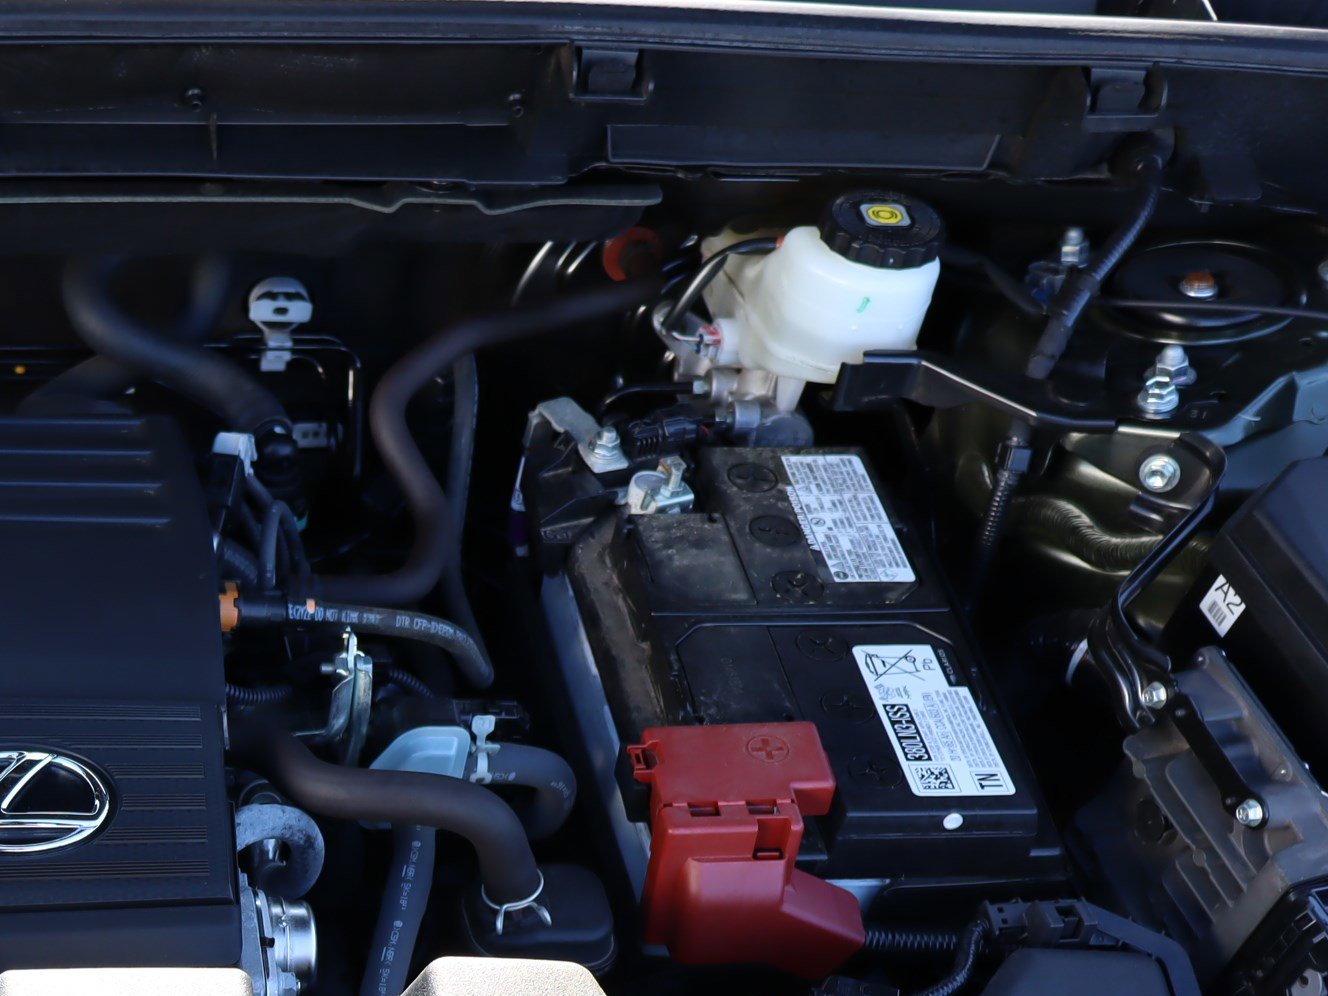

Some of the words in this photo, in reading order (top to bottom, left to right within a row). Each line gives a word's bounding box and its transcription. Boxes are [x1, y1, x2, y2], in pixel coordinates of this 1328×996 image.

[1215, 581, 1243, 616] A2
[922, 658, 936, 671] Pb
[885, 705, 929, 760] 380LN3-ISS
[974, 773, 1004, 790] TN
